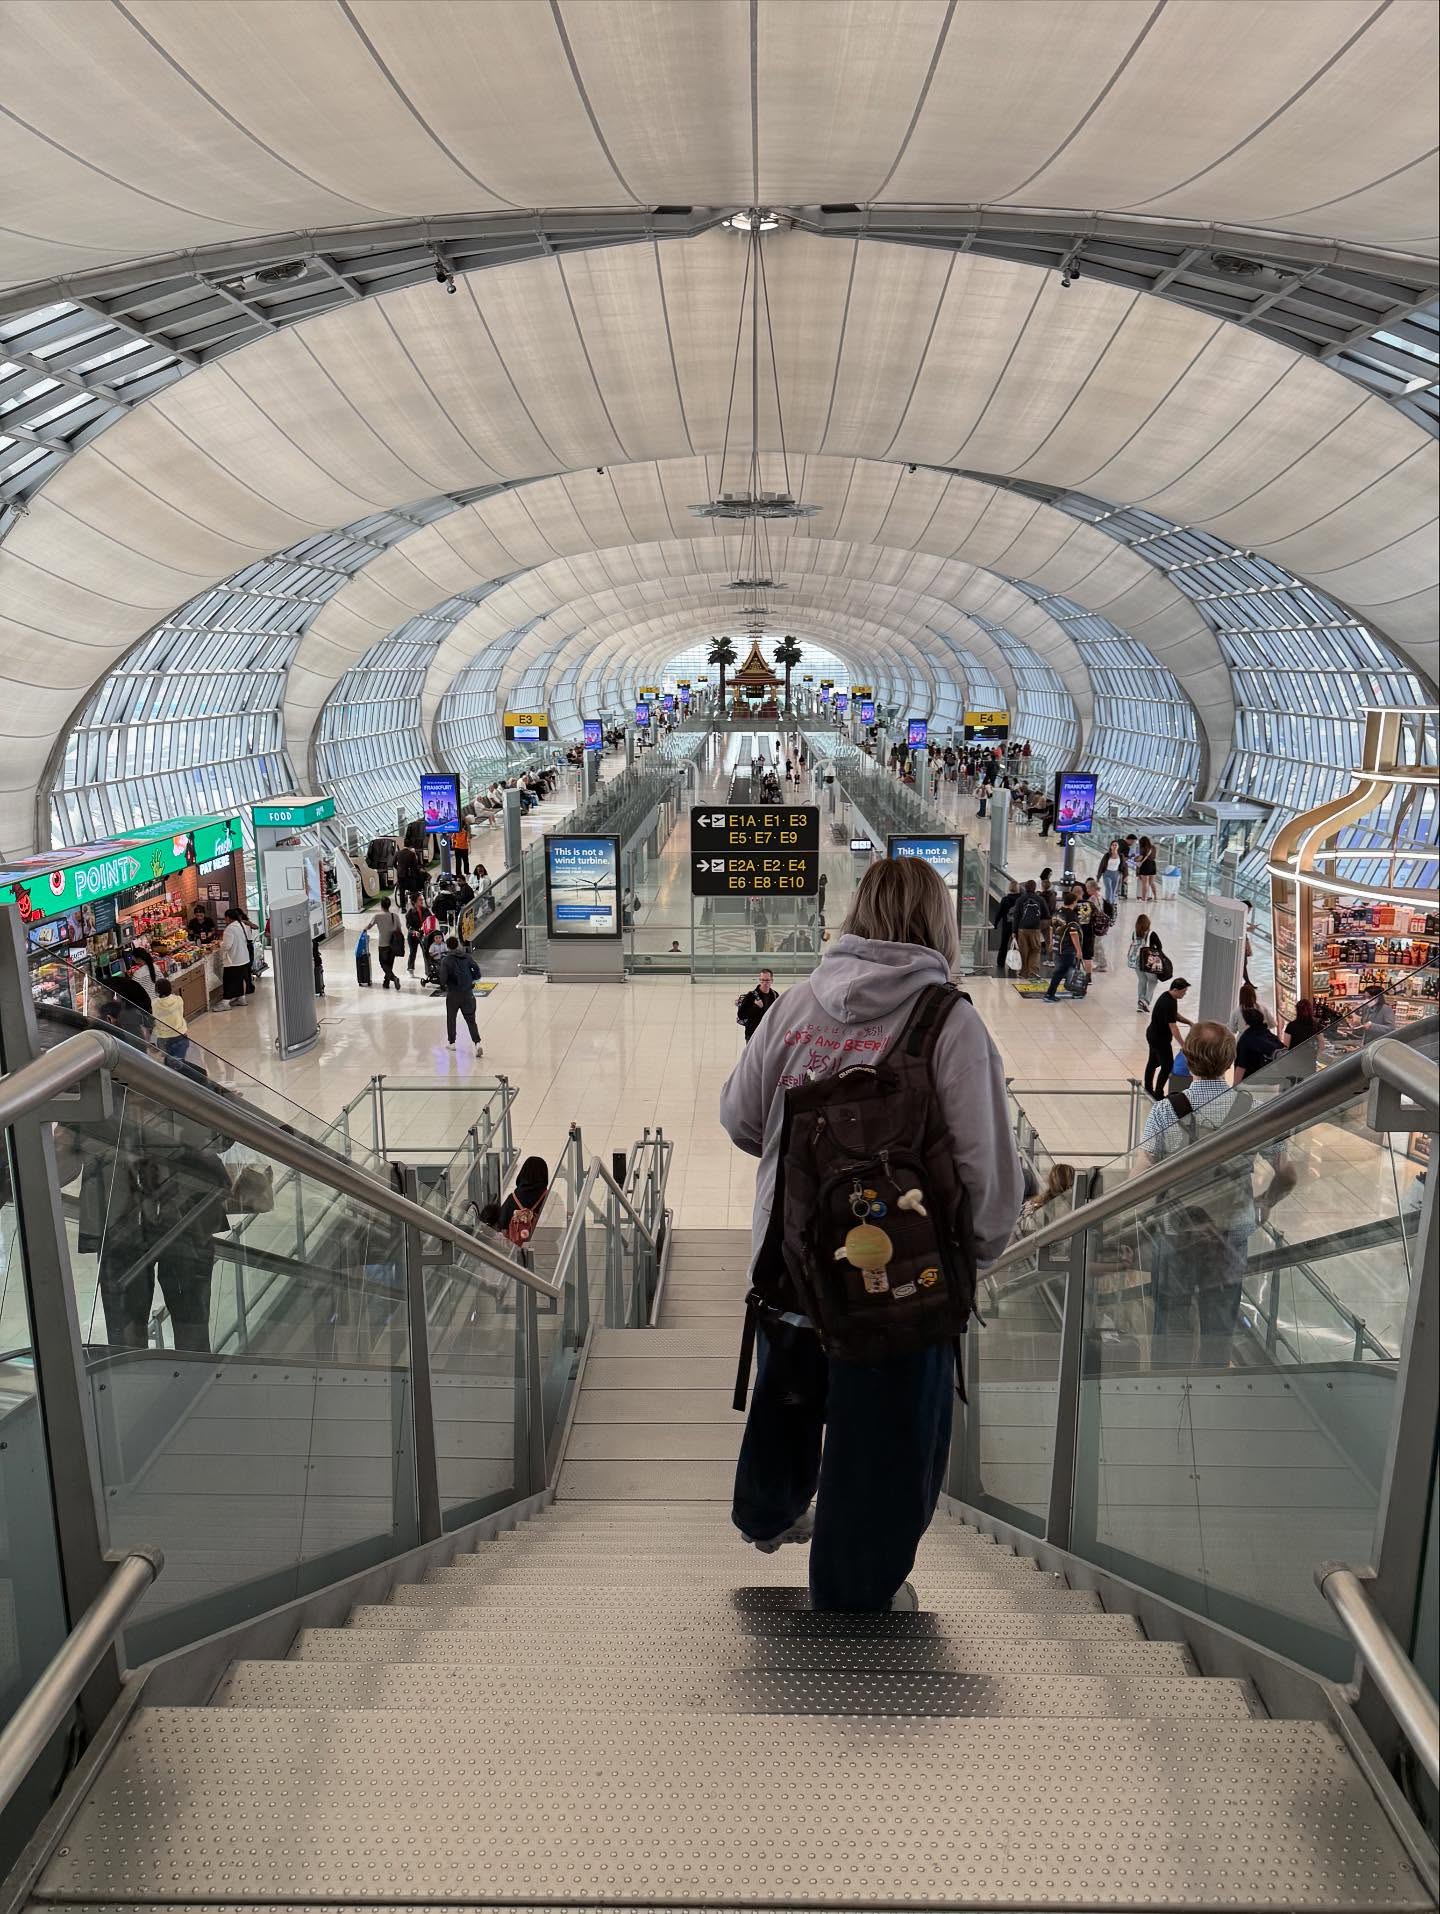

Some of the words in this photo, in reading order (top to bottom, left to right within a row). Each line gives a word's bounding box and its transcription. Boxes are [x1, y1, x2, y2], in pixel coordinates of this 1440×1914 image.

[519, 715, 532, 724] E3
[980, 714, 993, 723] E4
[269, 812, 292, 821] FOOD
[729, 815, 757, 827] E1A
[764, 815, 780, 827] E1
[789, 815, 807, 827] E3
[729, 832, 747, 844] E5
[755, 832, 772, 844] E7
[780, 832, 798, 844] E9
[728, 860, 756, 872] E2A
[763, 860, 781, 872] E2
[788, 860, 807, 872] E4
[728, 876, 746, 889] E6
[754, 876, 771, 889] E8
[779, 876, 804, 888] E10
[815, 1036, 841, 1051] AND
